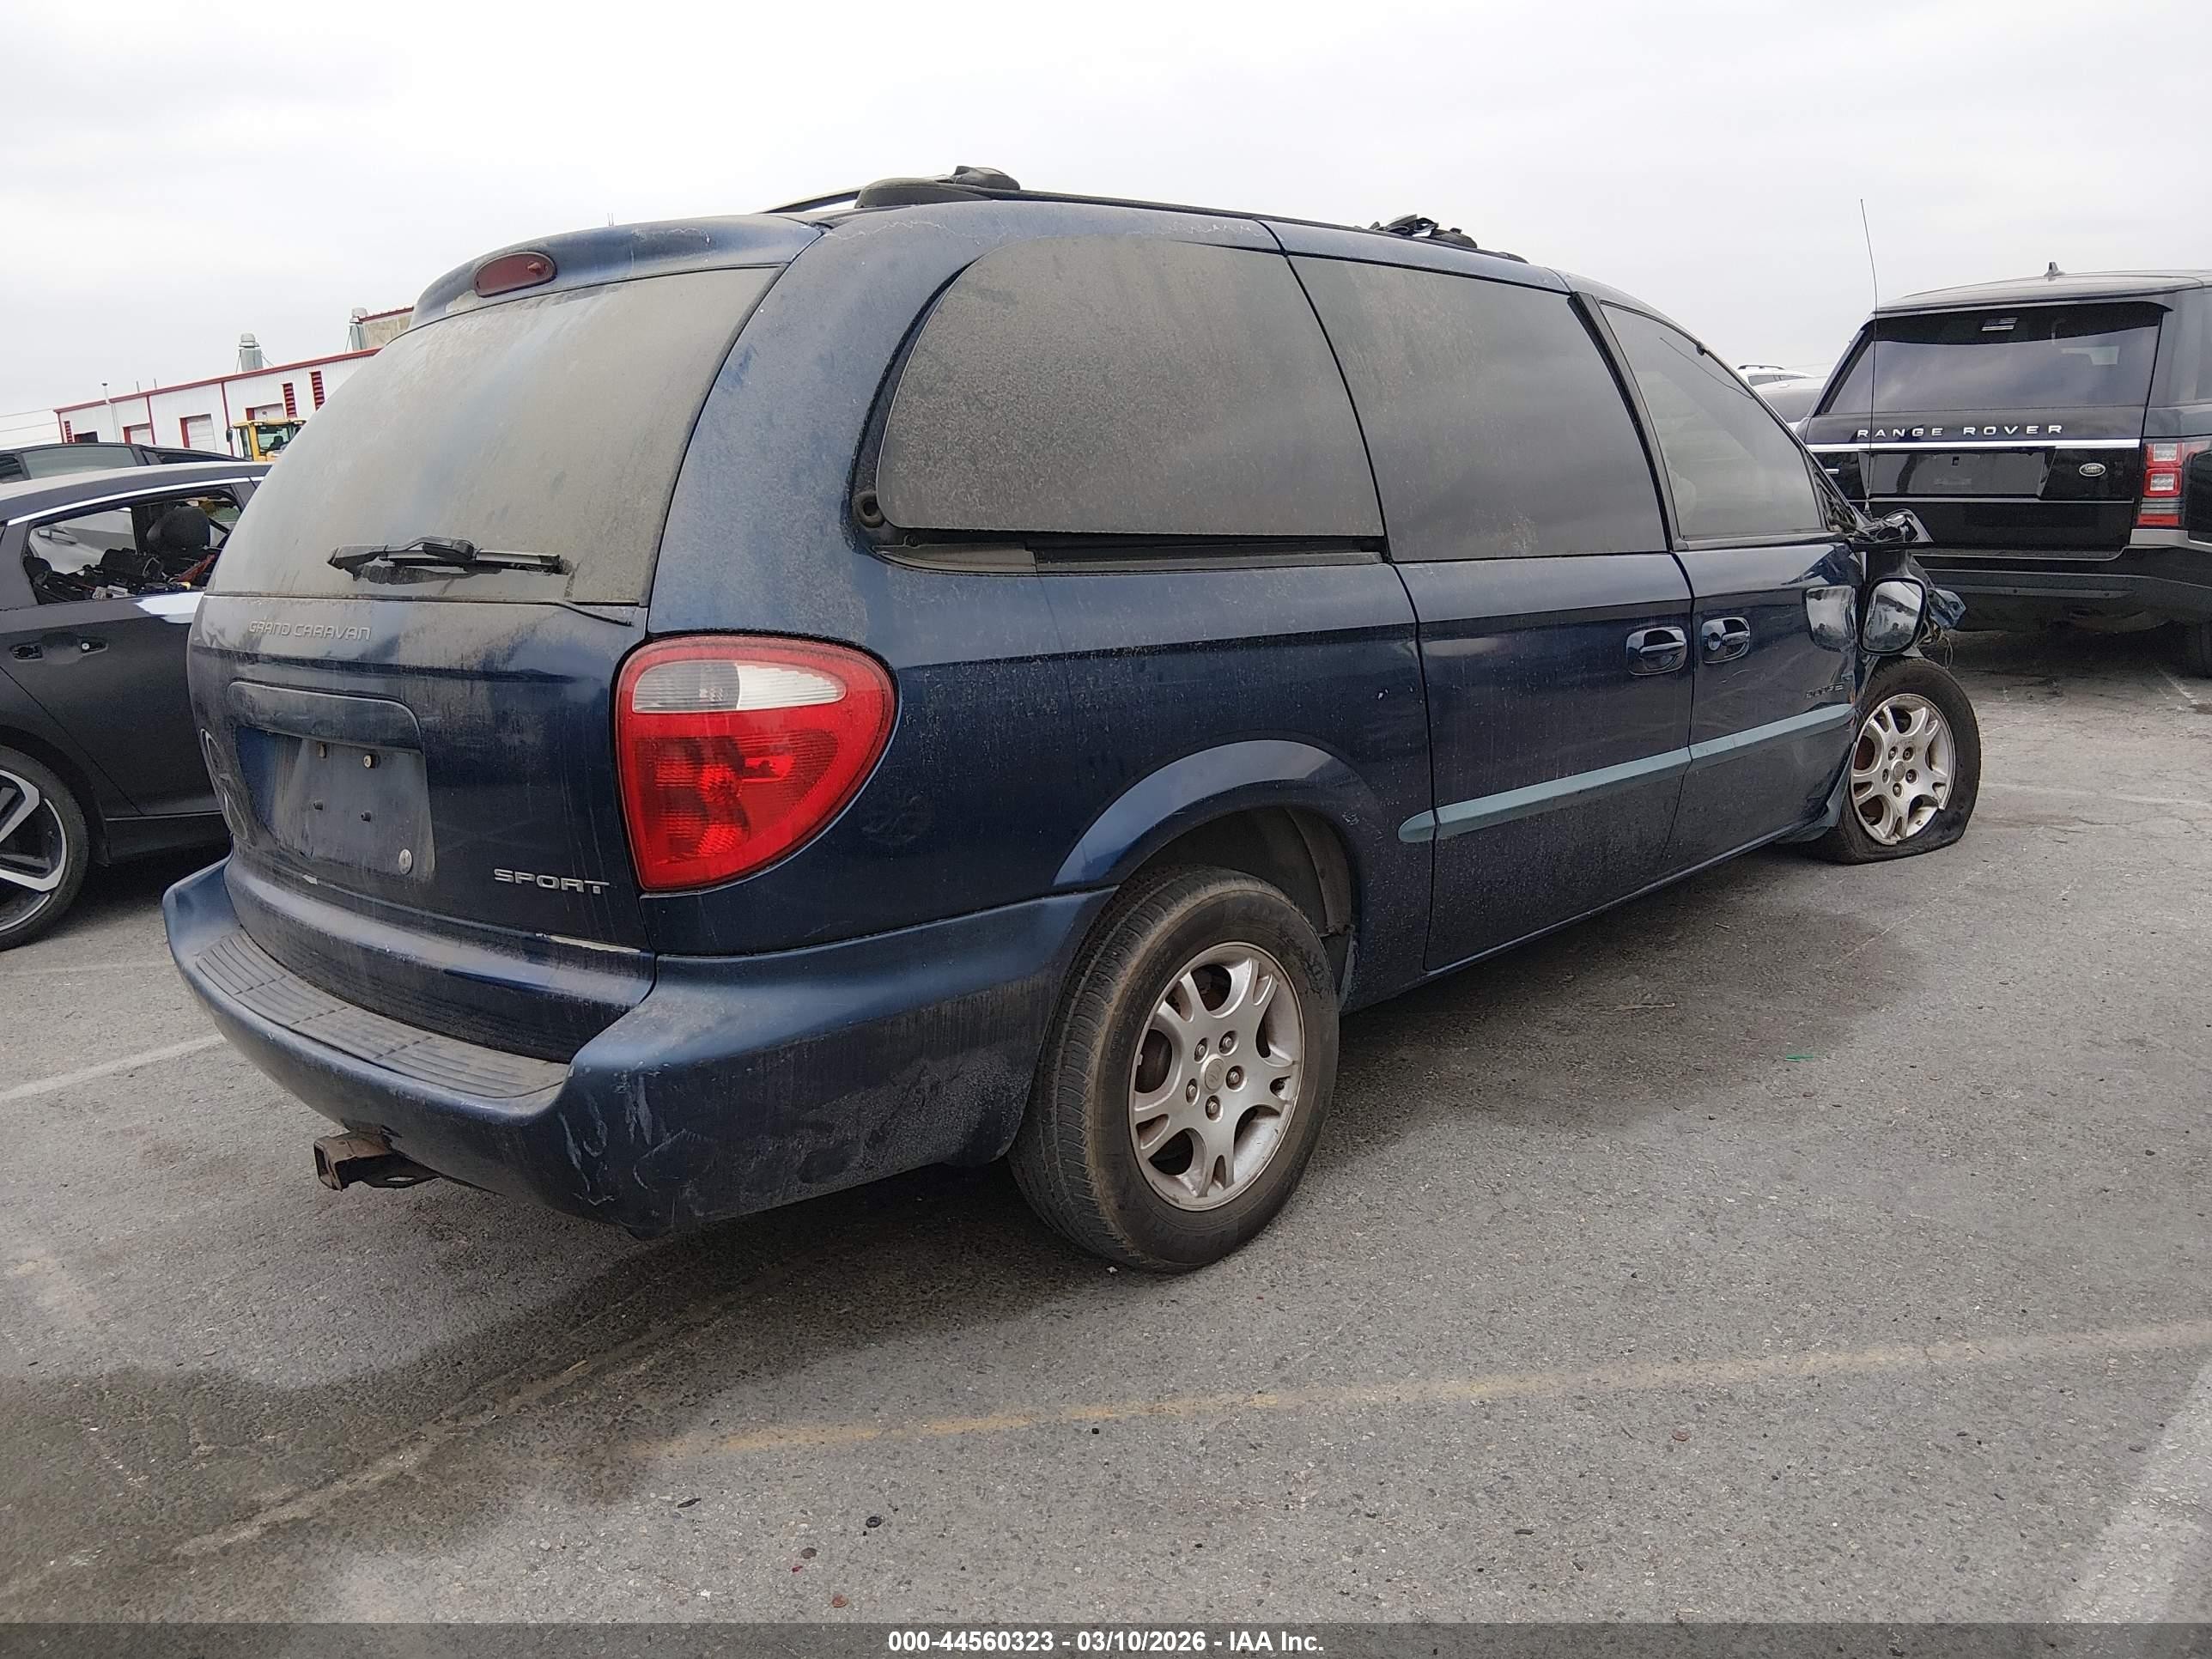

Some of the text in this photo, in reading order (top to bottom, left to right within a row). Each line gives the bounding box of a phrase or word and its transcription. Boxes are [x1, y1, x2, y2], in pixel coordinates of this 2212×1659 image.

[1856, 425, 2063, 438] RANGE ROVER
[249, 620, 372, 641] GRAND CARAVAN
[494, 868, 610, 894] SPORT
